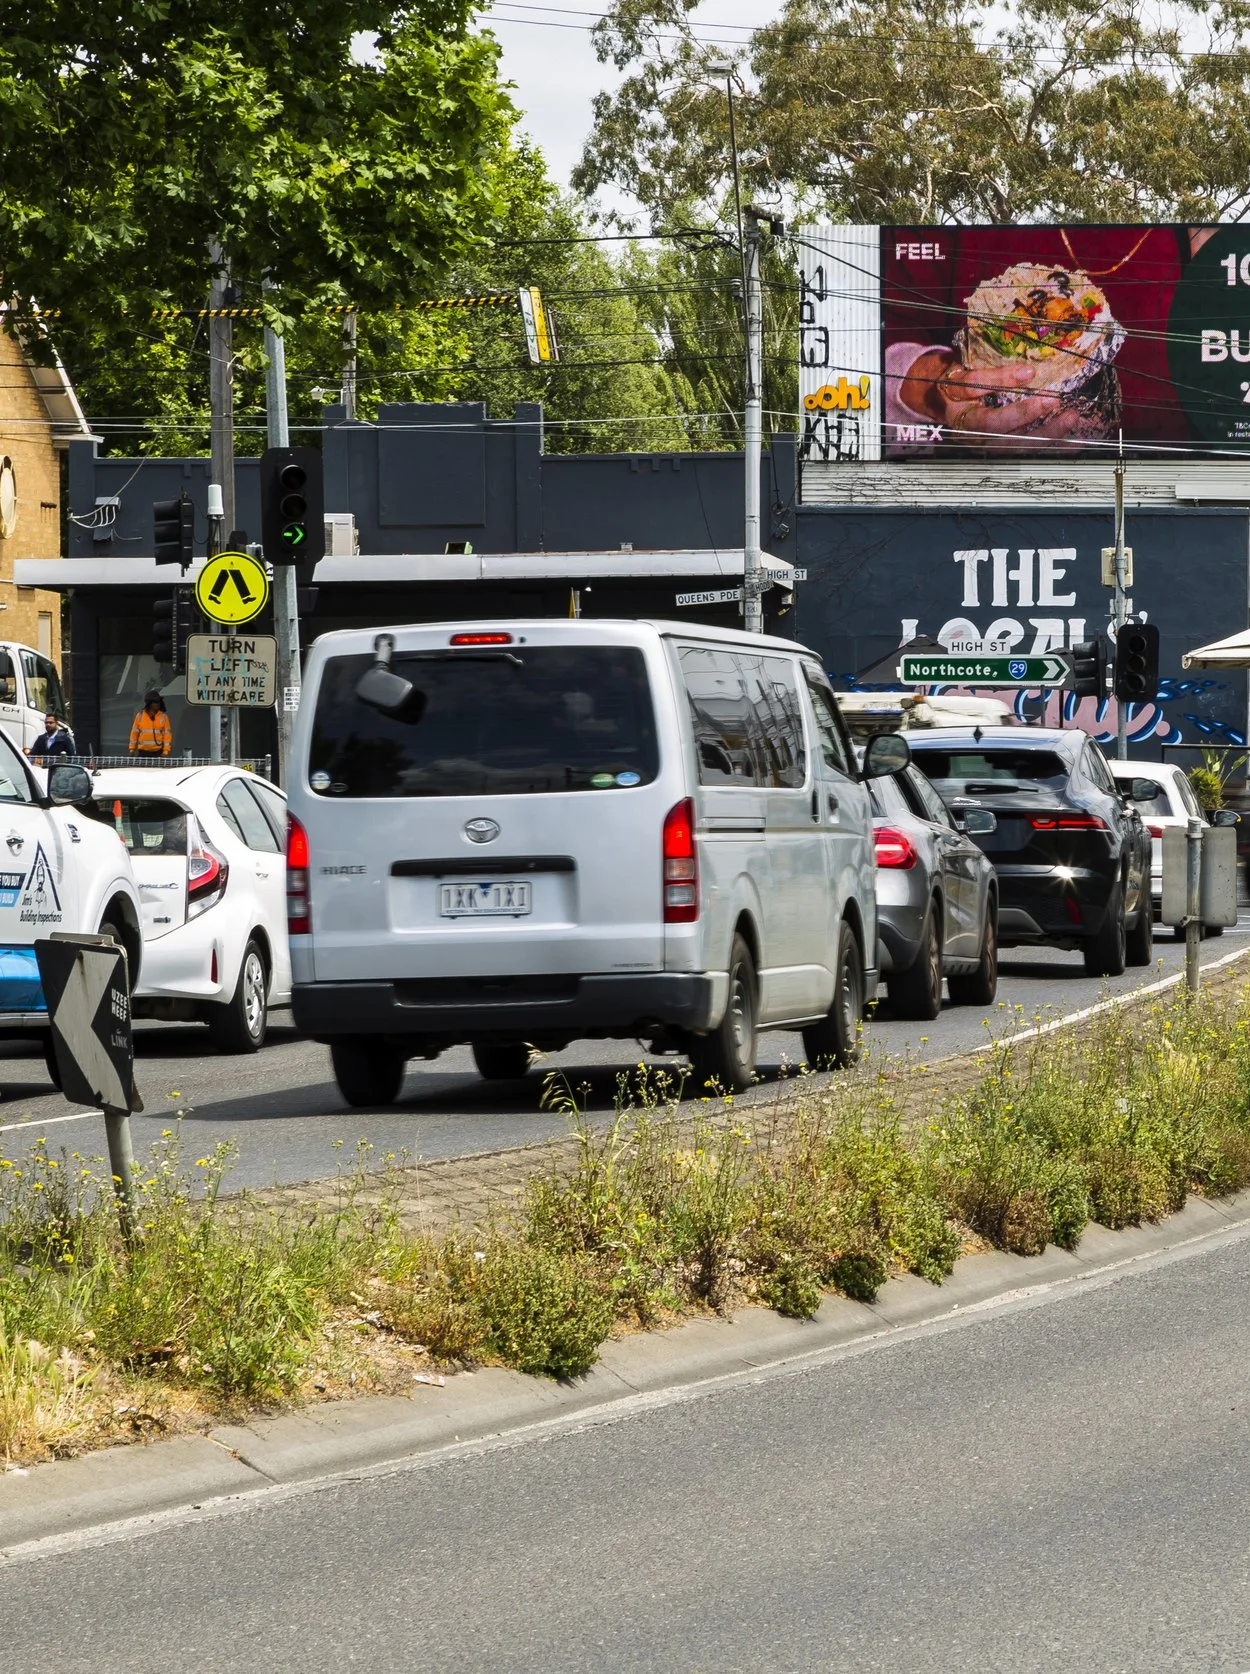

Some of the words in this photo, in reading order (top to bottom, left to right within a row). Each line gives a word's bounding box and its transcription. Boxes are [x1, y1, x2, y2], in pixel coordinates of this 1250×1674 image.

[895, 243, 945, 260] FEEL
[896, 424, 943, 441] MEX
[767, 570, 789, 579] HIGH
[794, 570, 806, 579] ST
[953, 548, 1077, 607] THE
[677, 593, 715, 605] QUEENS
[720, 591, 739, 600] PDE
[208, 640, 255, 654] TURN
[950, 641, 983, 652] HIGH
[989, 641, 1007, 652] ST
[211, 658, 251, 672] LEFT
[1011, 663, 1026, 674] 29
[197, 676, 210, 686] AT
[215, 676, 237, 687] ANY
[242, 676, 266, 688] TIME
[197, 690, 226, 701] WITH
[232, 690, 265, 702] CARE
[20, 909, 37, 925] Building
[37, 910, 62, 925] Inspections
